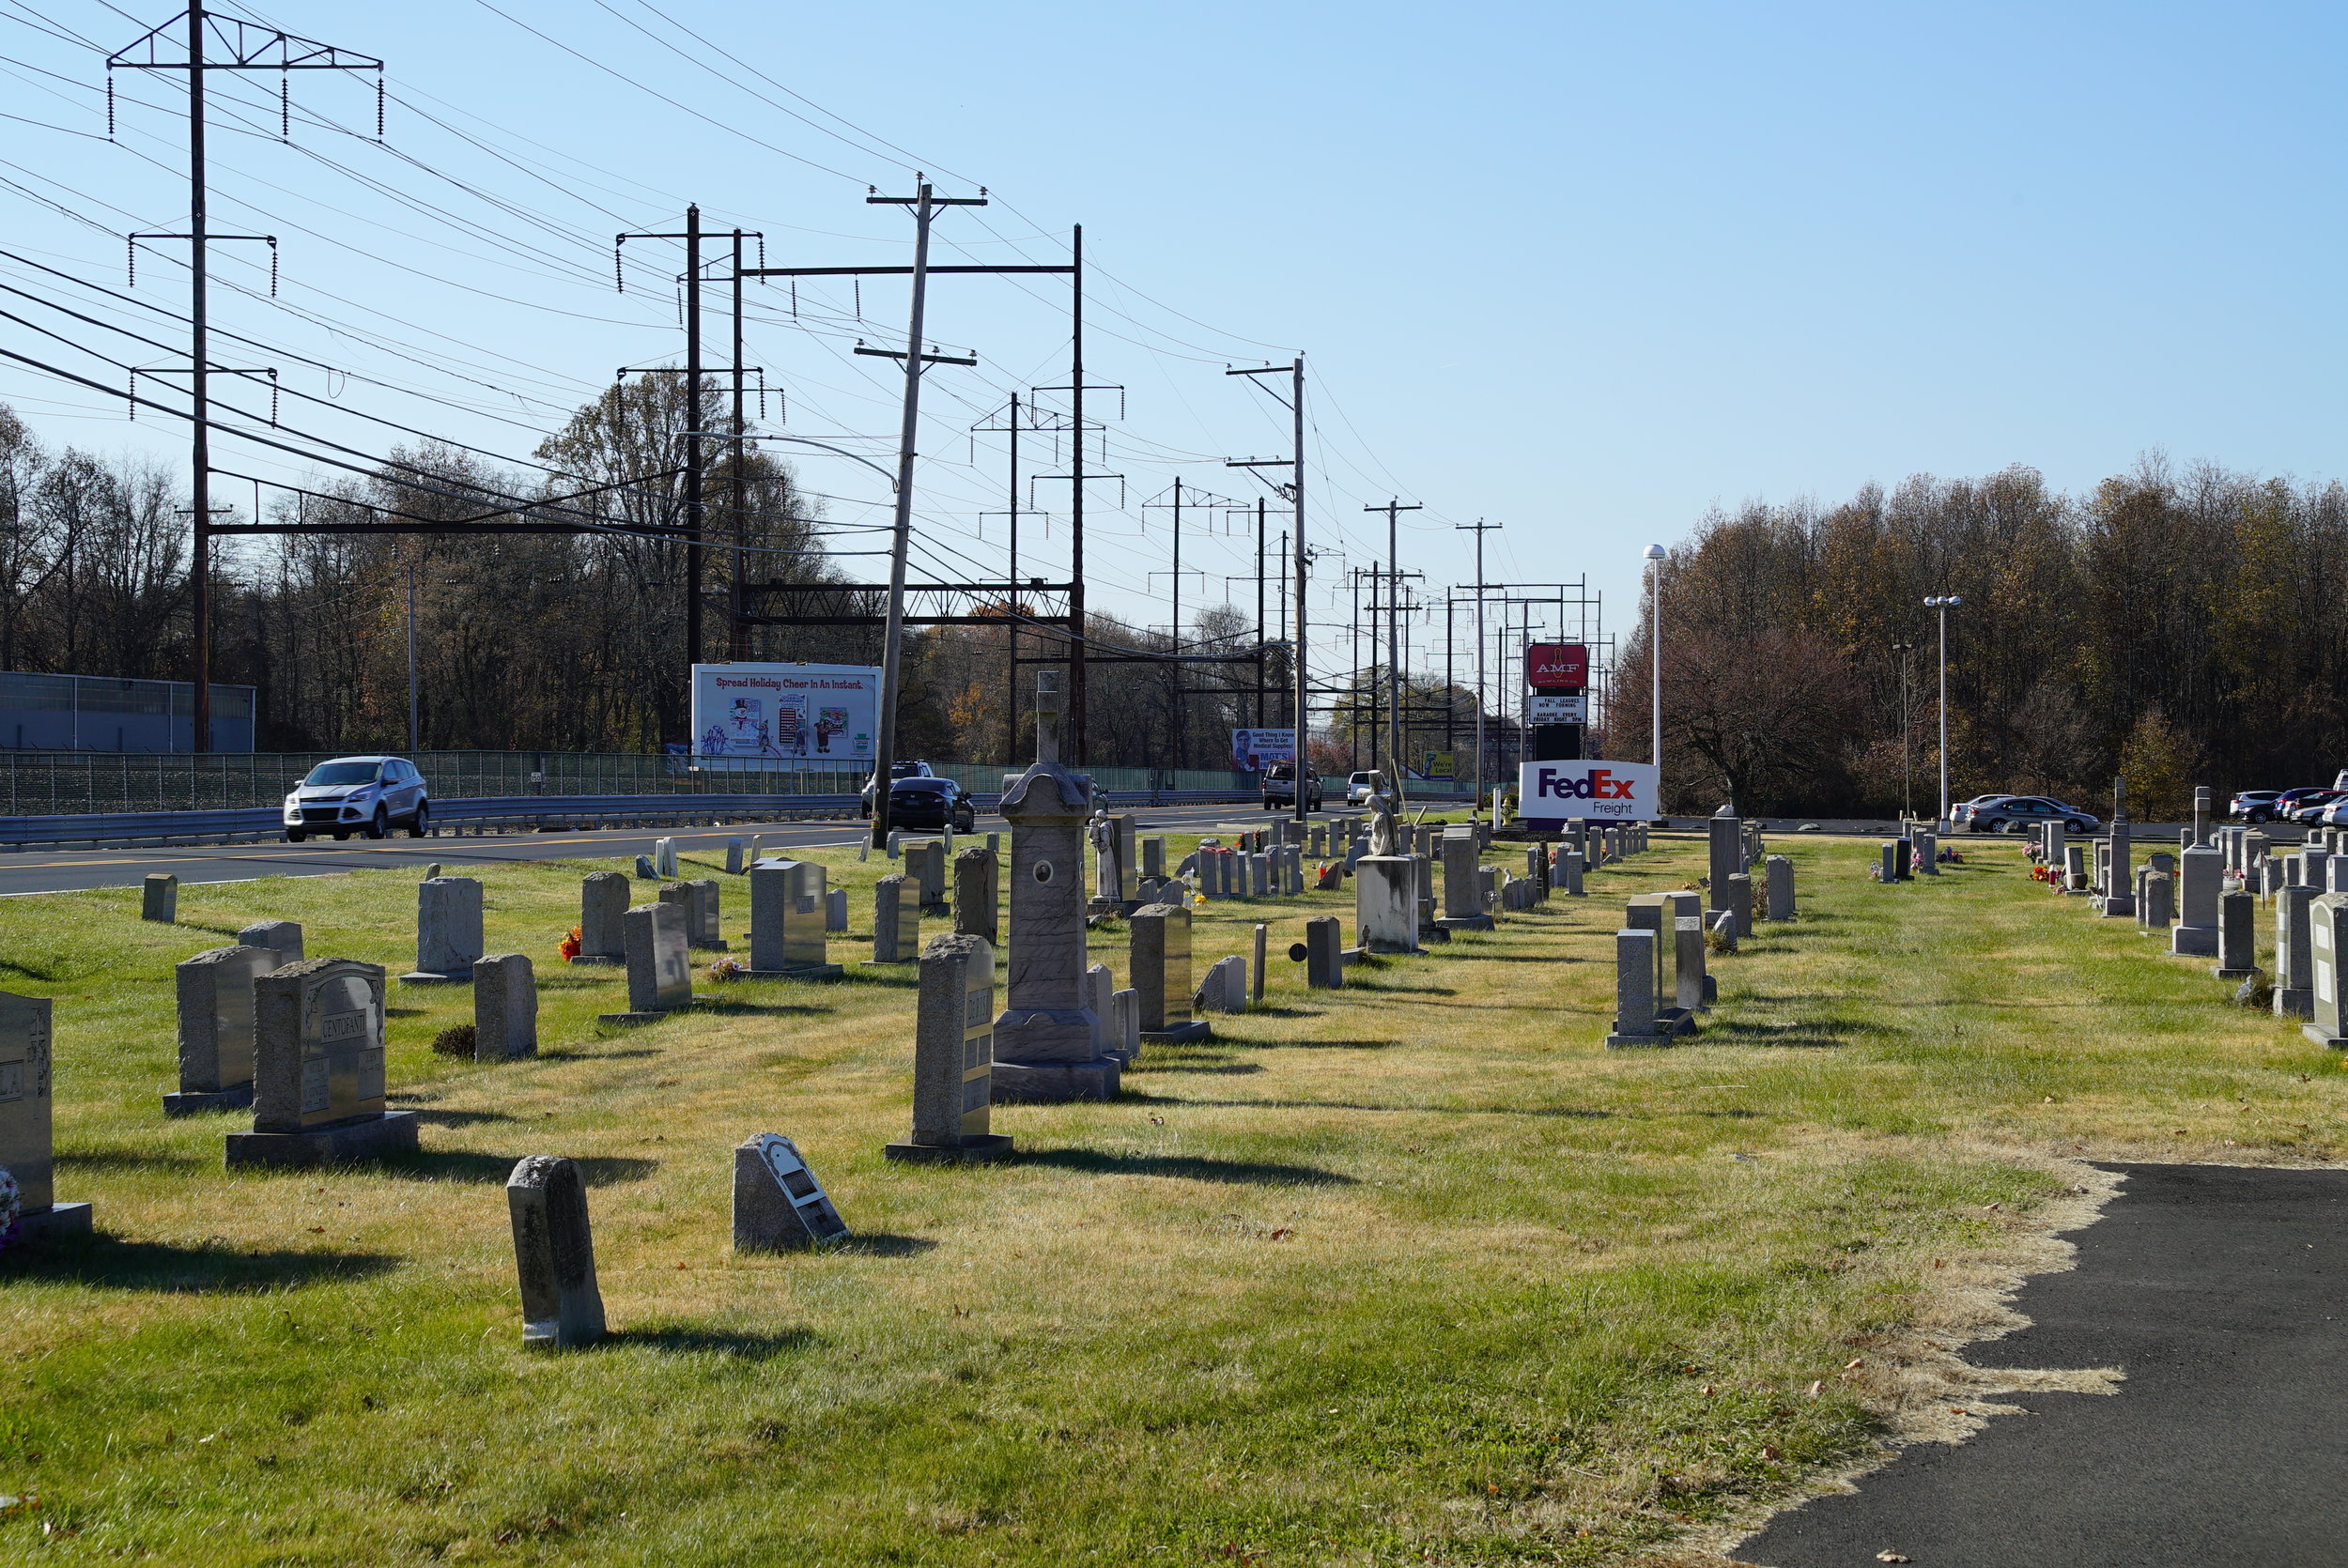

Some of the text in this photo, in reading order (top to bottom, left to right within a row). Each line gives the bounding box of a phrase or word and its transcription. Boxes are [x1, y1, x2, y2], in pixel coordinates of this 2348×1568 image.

[1537, 664, 1579, 673] AMF
[716, 677, 863, 691] Spread Holiday Cheer In An Instant.
[1538, 768, 1635, 799] FedEx
[1593, 802, 1632, 816] Freight
[322, 1014, 365, 1038] CENTOFANTI
